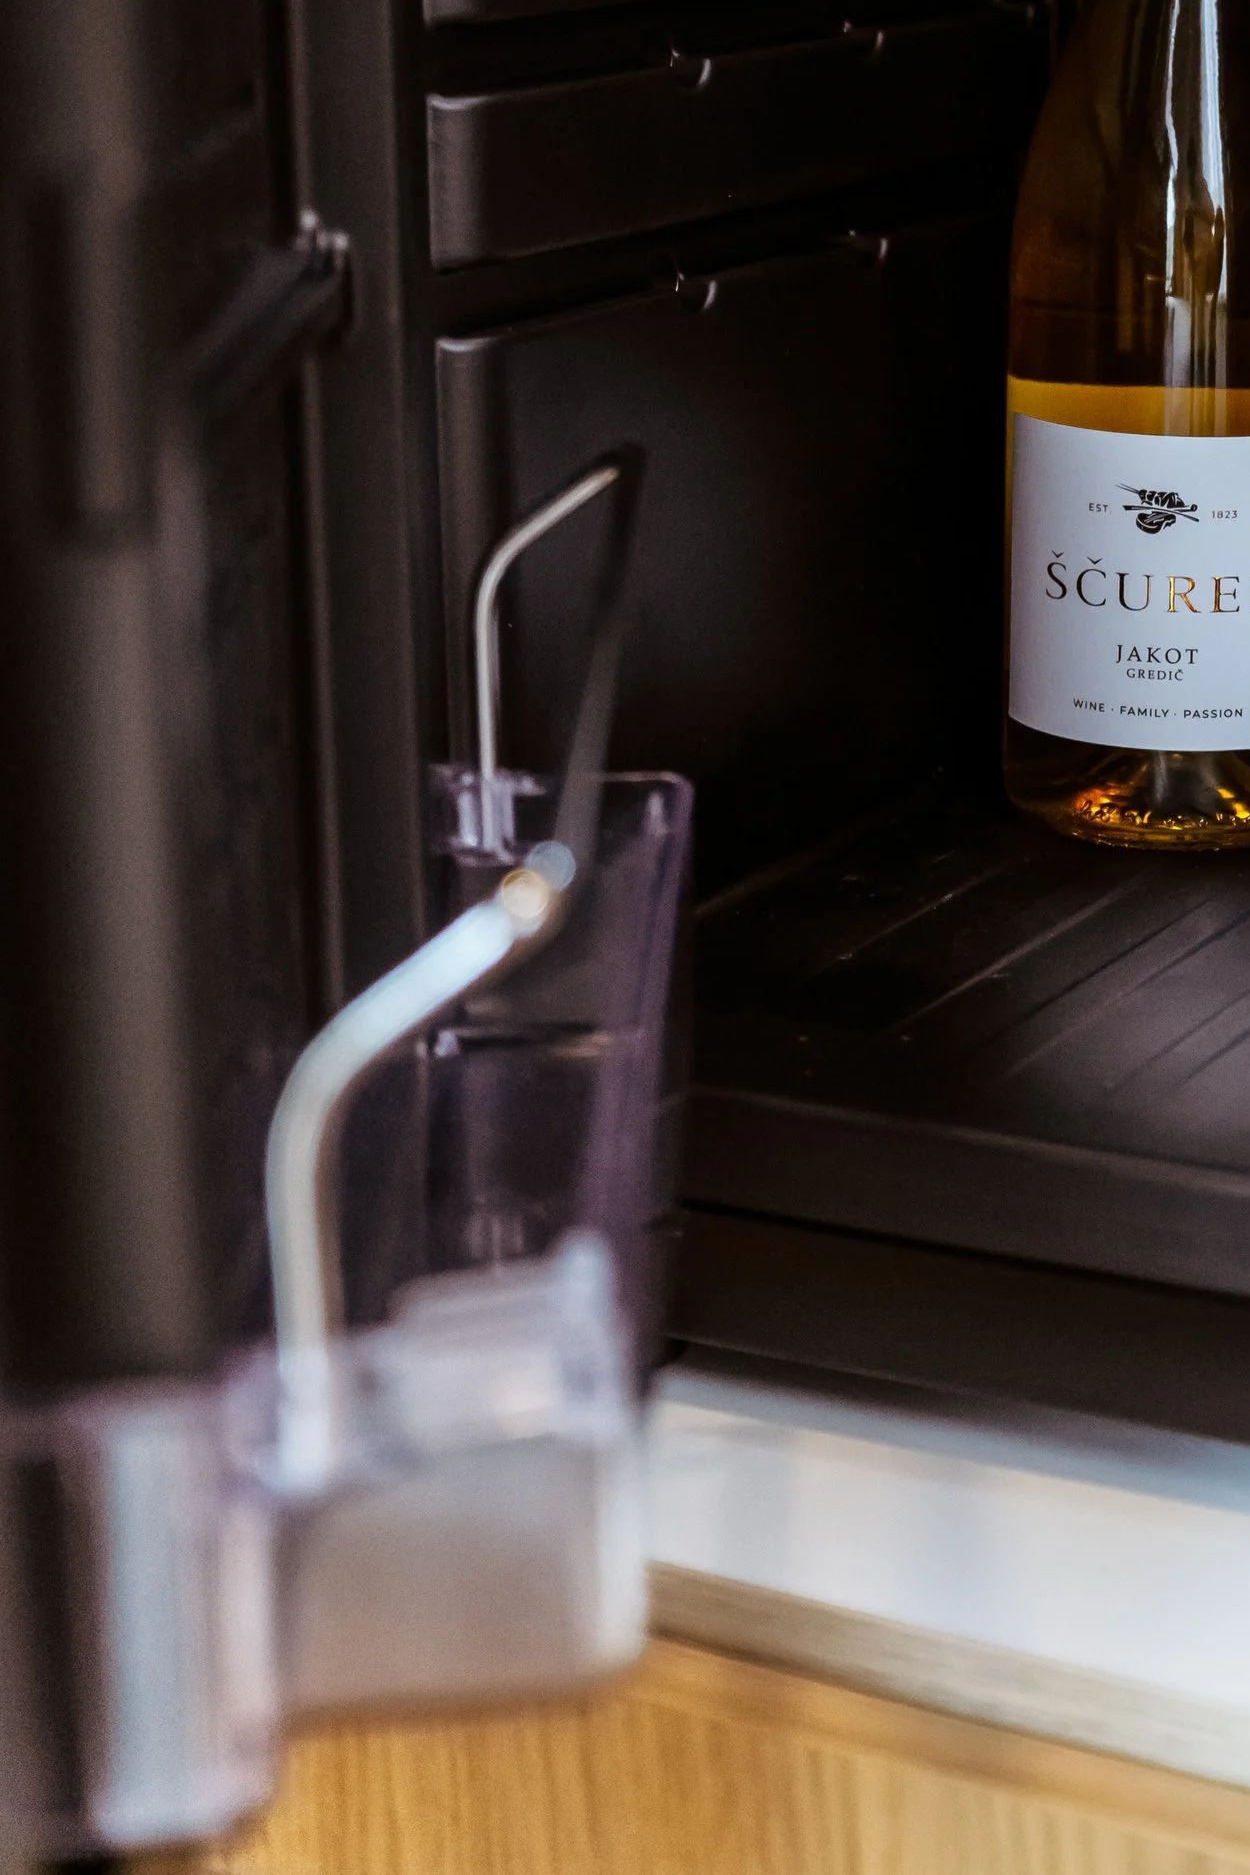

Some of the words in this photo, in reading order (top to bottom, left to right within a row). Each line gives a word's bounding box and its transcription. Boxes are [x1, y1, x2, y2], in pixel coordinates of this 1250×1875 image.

[1088, 502, 1111, 514] EST.
[1210, 509, 1237, 519] 1823
[1115, 644, 1198, 664] JAKOT
[1125, 668, 1183, 681] GREDIČ
[1072, 698, 1105, 712] WINE
[1119, 705, 1169, 718] FAMILY
[1183, 708, 1242, 718] PASSION
